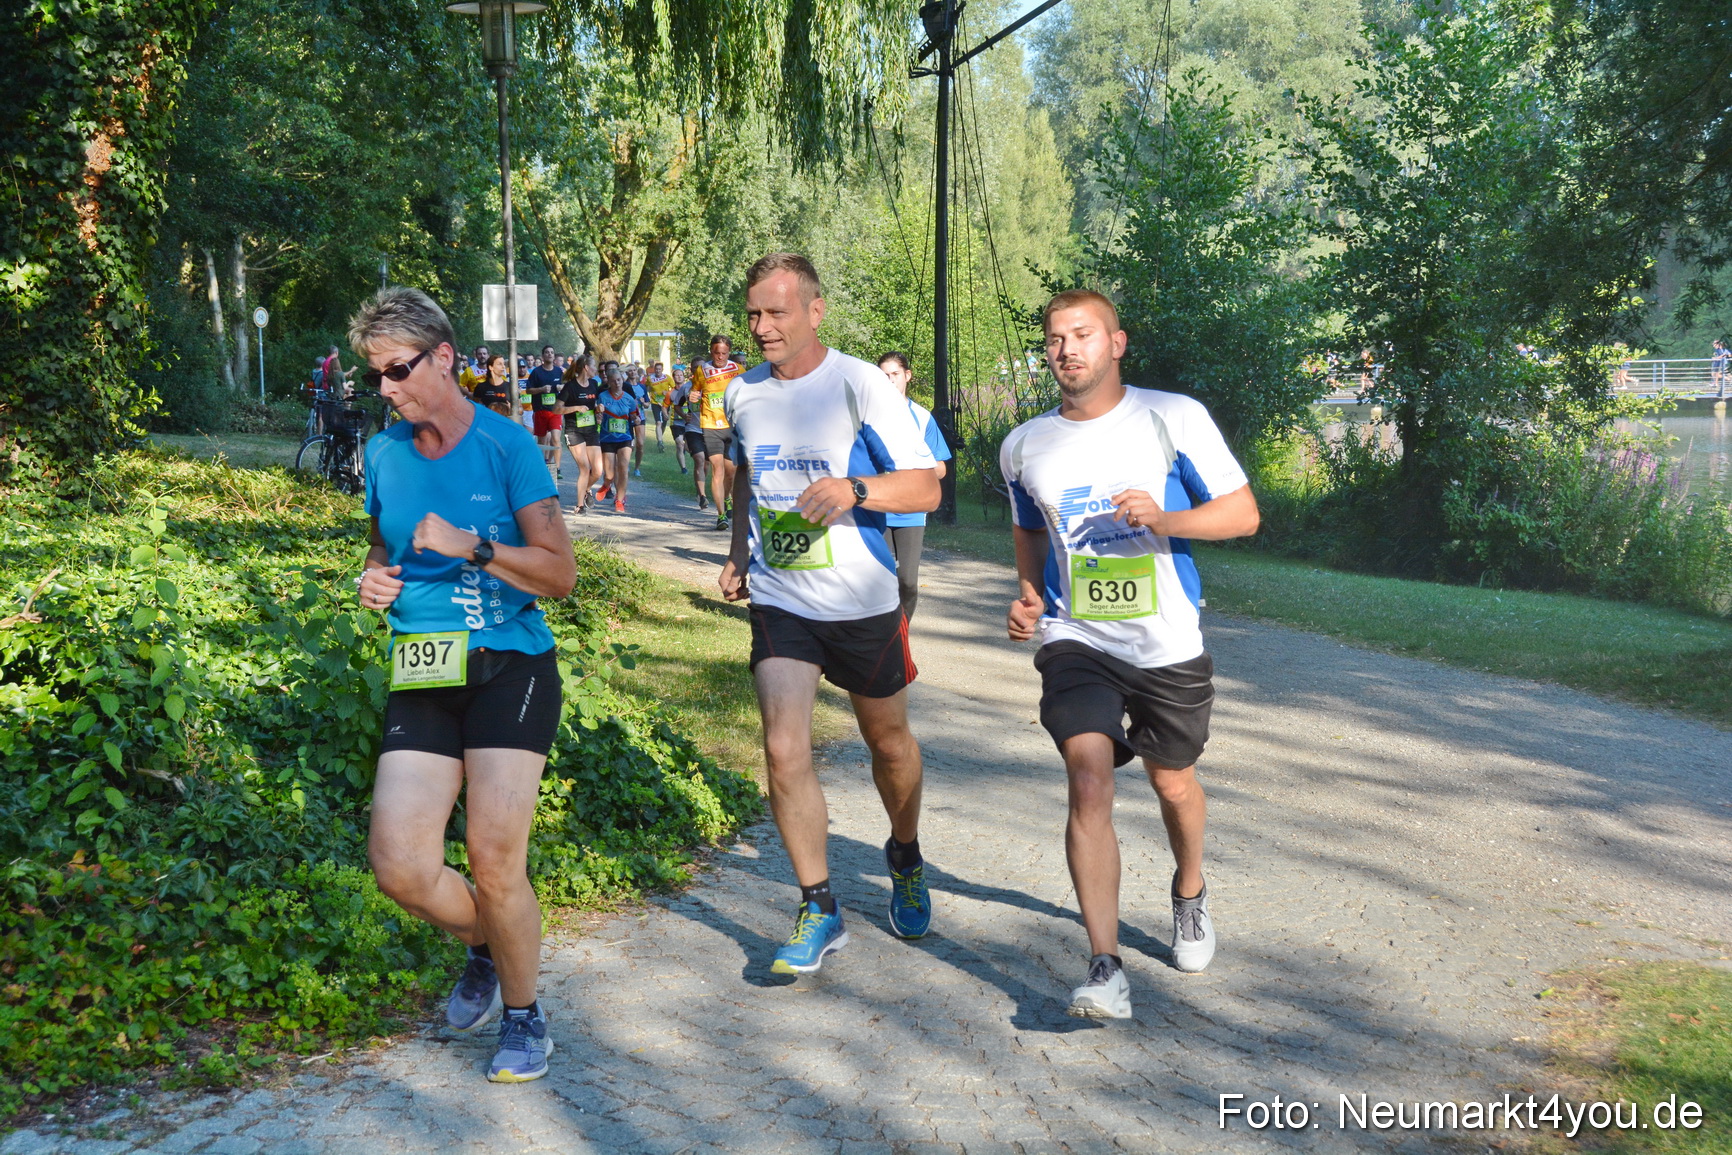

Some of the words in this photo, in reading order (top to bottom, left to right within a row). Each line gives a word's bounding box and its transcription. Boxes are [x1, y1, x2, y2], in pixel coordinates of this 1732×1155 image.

[470, 493, 493, 502] Alex
[771, 531, 810, 554] 629
[1088, 580, 1137, 602] 630
[398, 640, 455, 669] 1397
